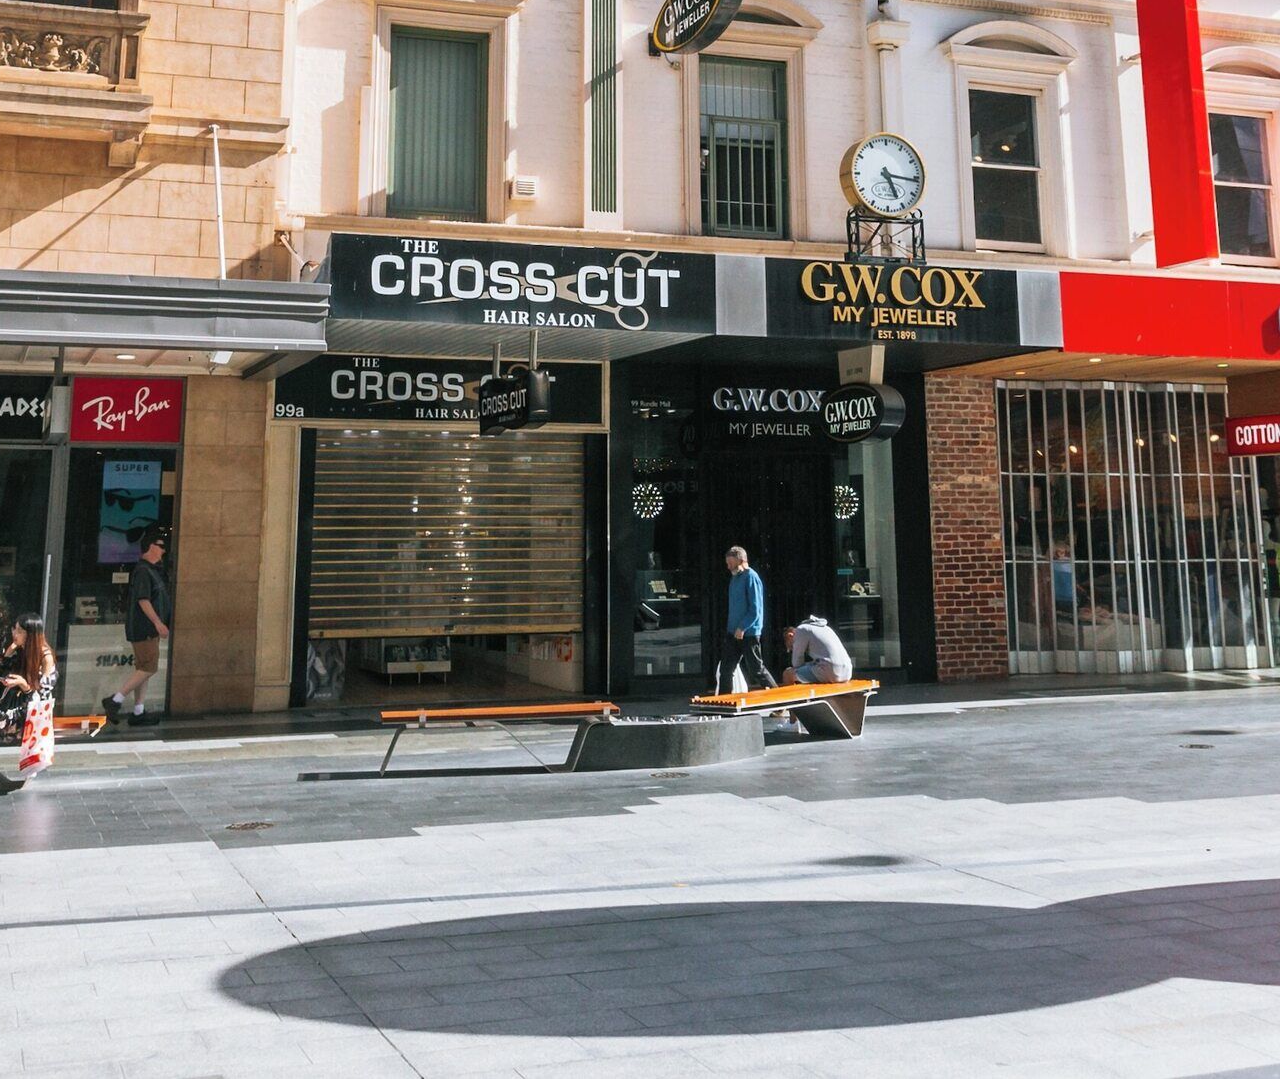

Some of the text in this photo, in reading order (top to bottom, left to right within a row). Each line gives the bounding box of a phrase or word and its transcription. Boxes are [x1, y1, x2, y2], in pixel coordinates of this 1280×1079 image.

[675, 0, 710, 37] JEWELLER
[401, 239, 439, 255] THE
[371, 254, 681, 309] CROSS CUT
[483, 309, 596, 328] HAIR SALON
[833, 305, 958, 327] MY JEWELLER
[877, 329, 917, 340] EST. 1898
[353, 357, 380, 369] THE
[330, 369, 465, 403] CROSS
[275, 403, 305, 418] 99a
[481, 388, 528, 417] CROSS CUT
[415, 407, 481, 420] HAIR SAL
[729, 422, 812, 439] MY JEWELLER
[829, 419, 871, 435] MY JEWELLER
[114, 462, 151, 473] SUPER
[96, 654, 136, 667] SHADE
